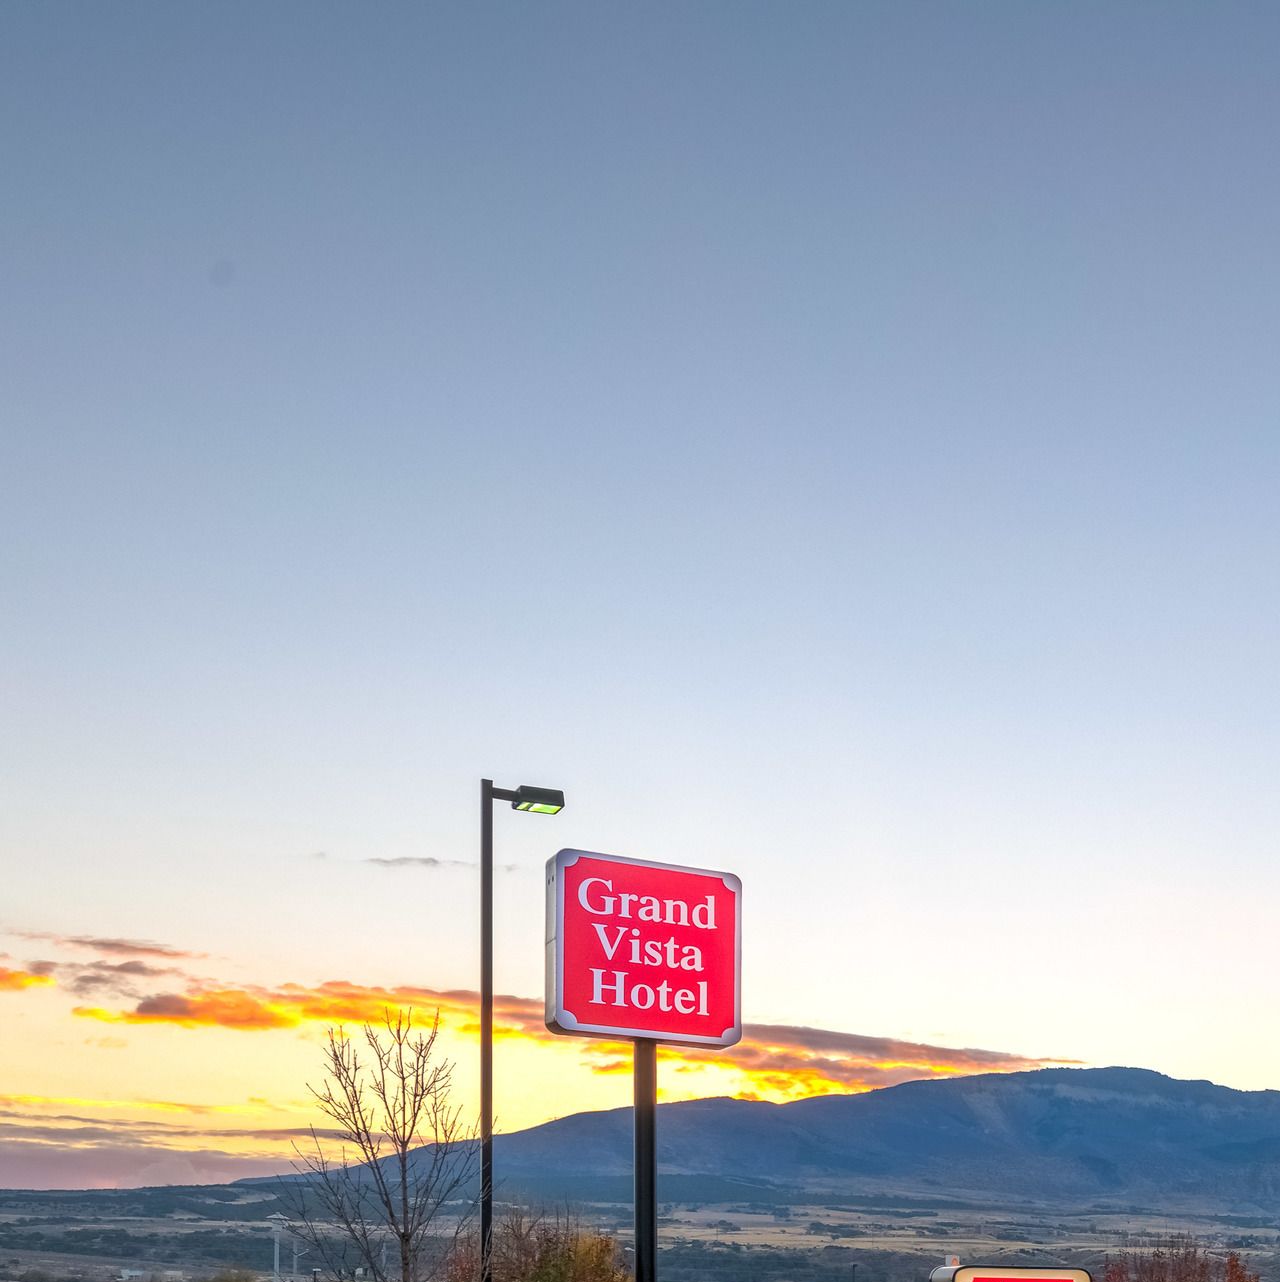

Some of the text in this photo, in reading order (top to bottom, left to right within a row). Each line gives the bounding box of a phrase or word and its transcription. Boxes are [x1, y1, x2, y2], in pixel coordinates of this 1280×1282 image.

[577, 877, 718, 930] Grand
[591, 923, 704, 972] Vista
[589, 967, 710, 1016] Hotel
